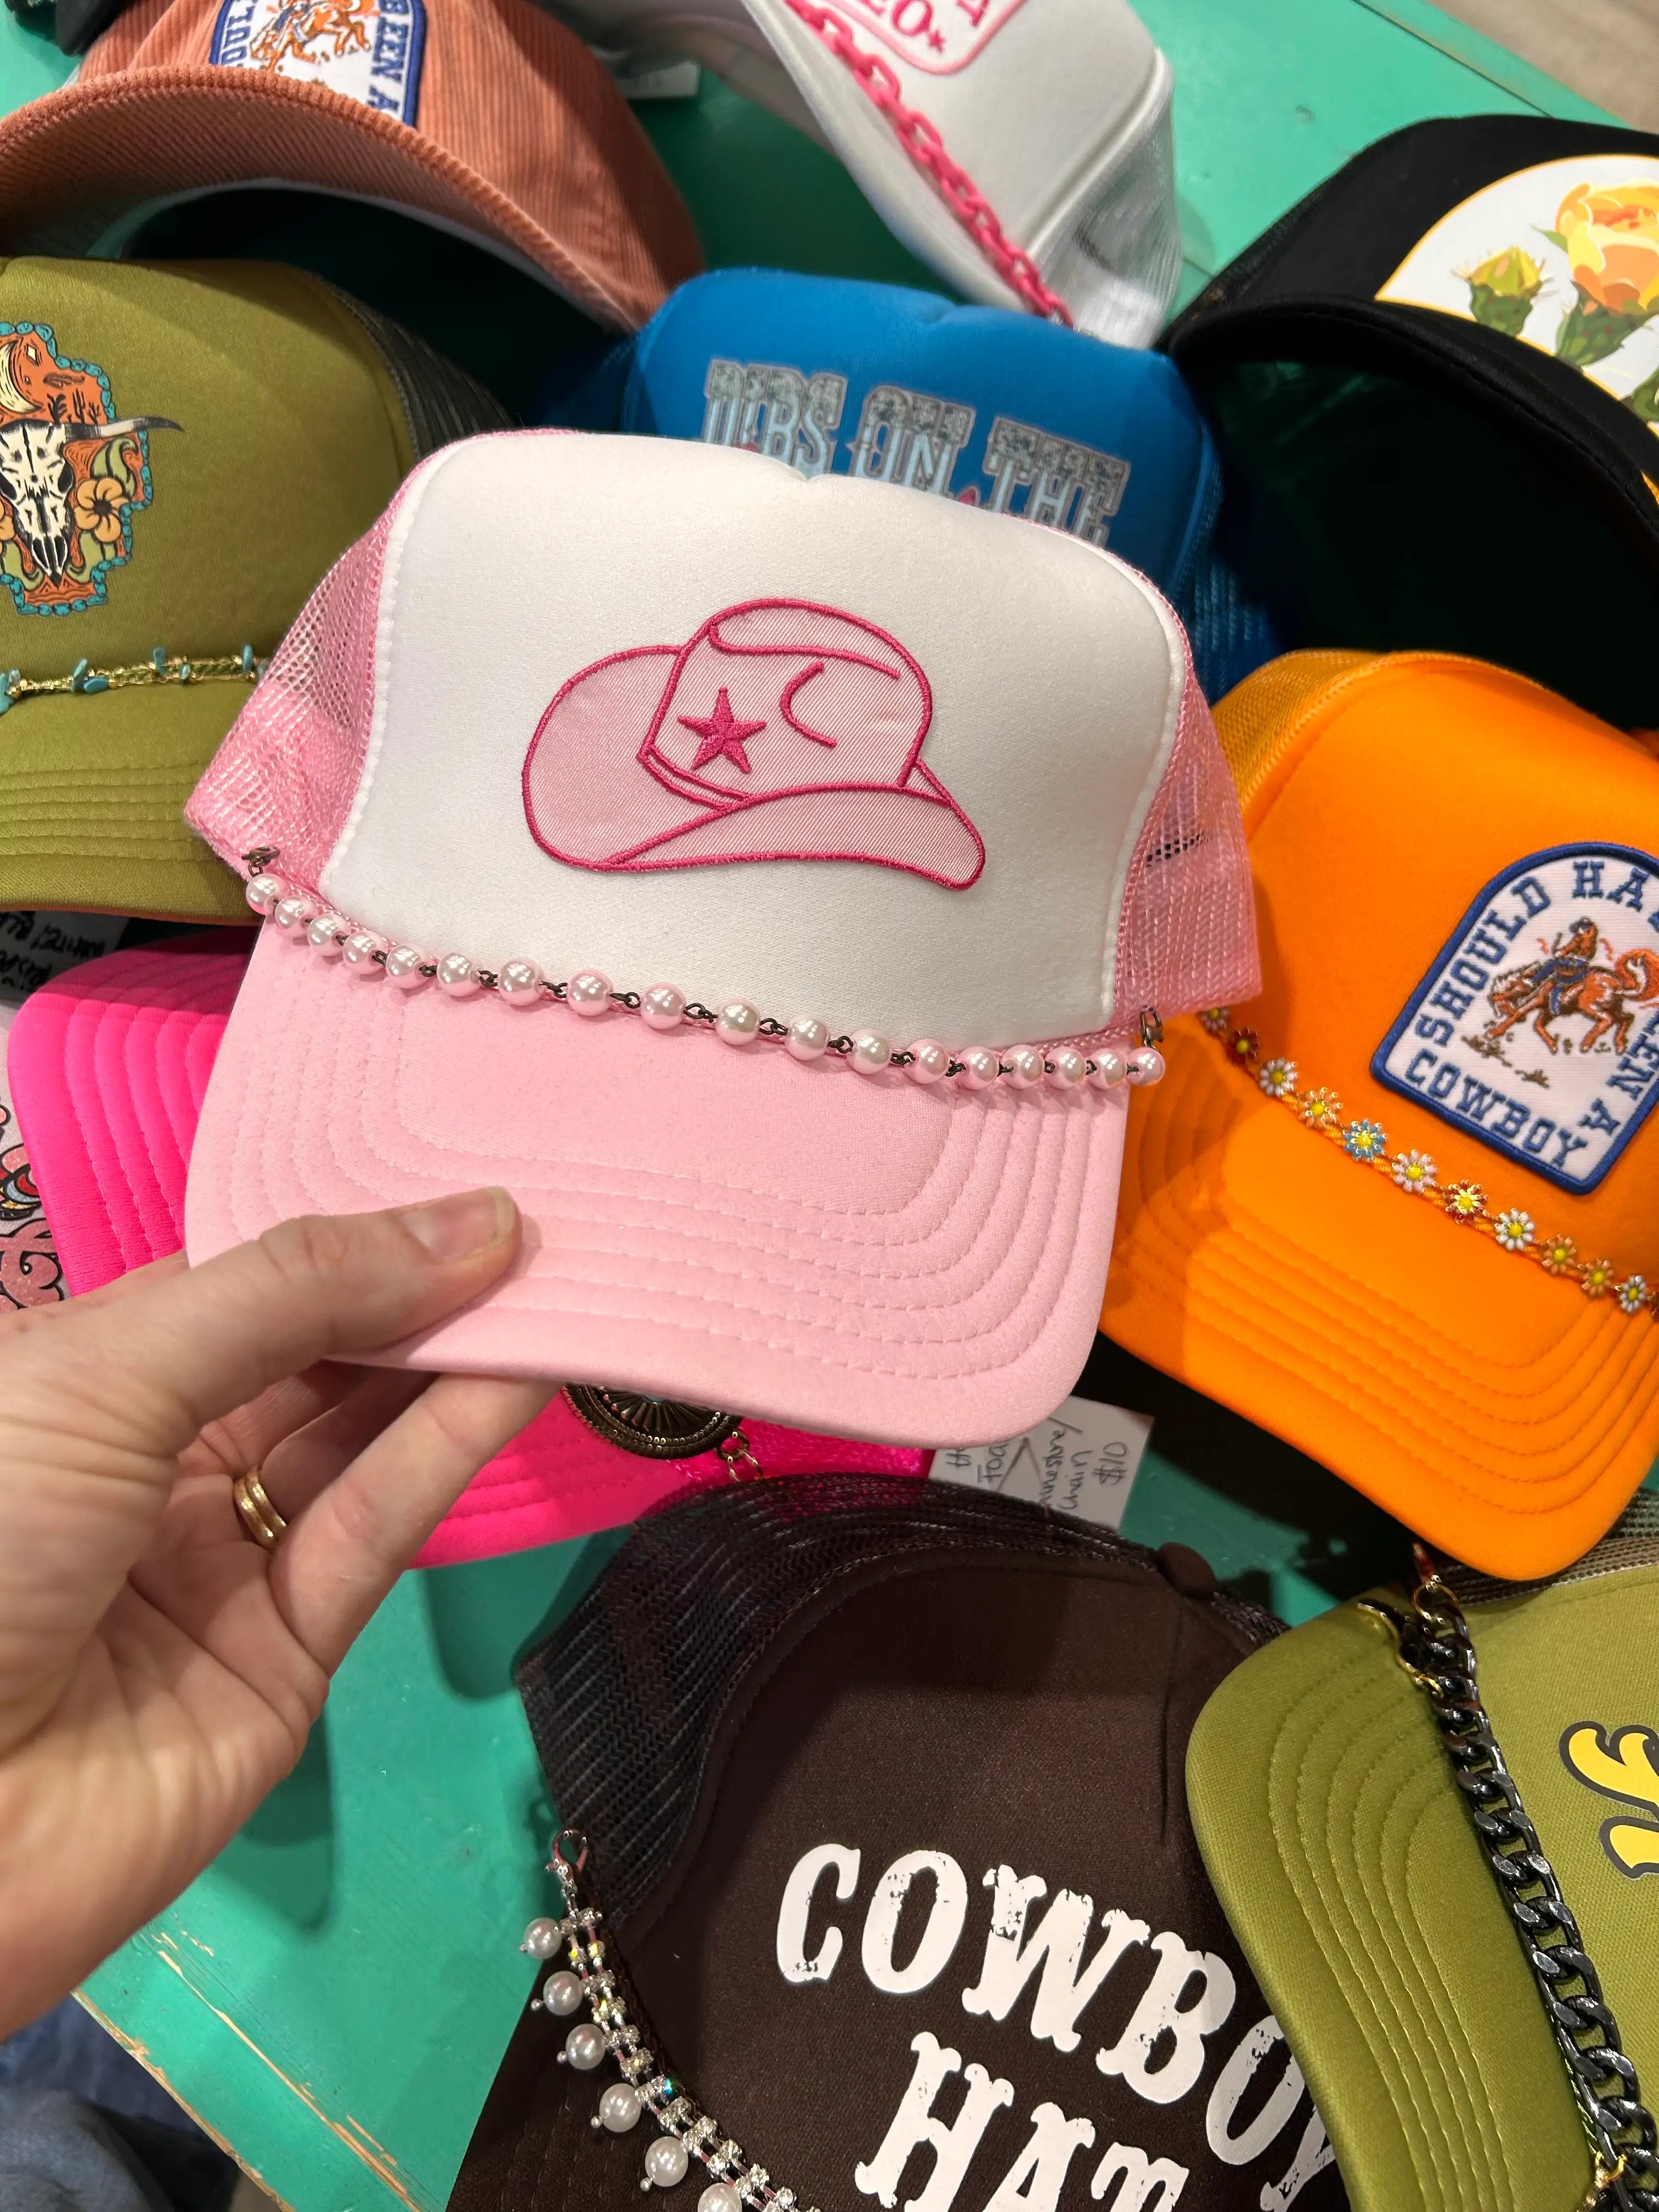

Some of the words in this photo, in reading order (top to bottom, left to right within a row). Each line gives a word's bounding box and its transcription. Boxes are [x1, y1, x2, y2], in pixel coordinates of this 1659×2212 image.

[848, 385, 975, 495] ON
[983, 416, 1131, 548] THE
[1415, 876, 1551, 1047] SHOULD
[1579, 1099, 1620, 1136] A
[1404, 1049, 1587, 1167] COWBOY
[978, 1443, 1008, 1483] Foa
[1093, 1441, 1129, 1485] $10
